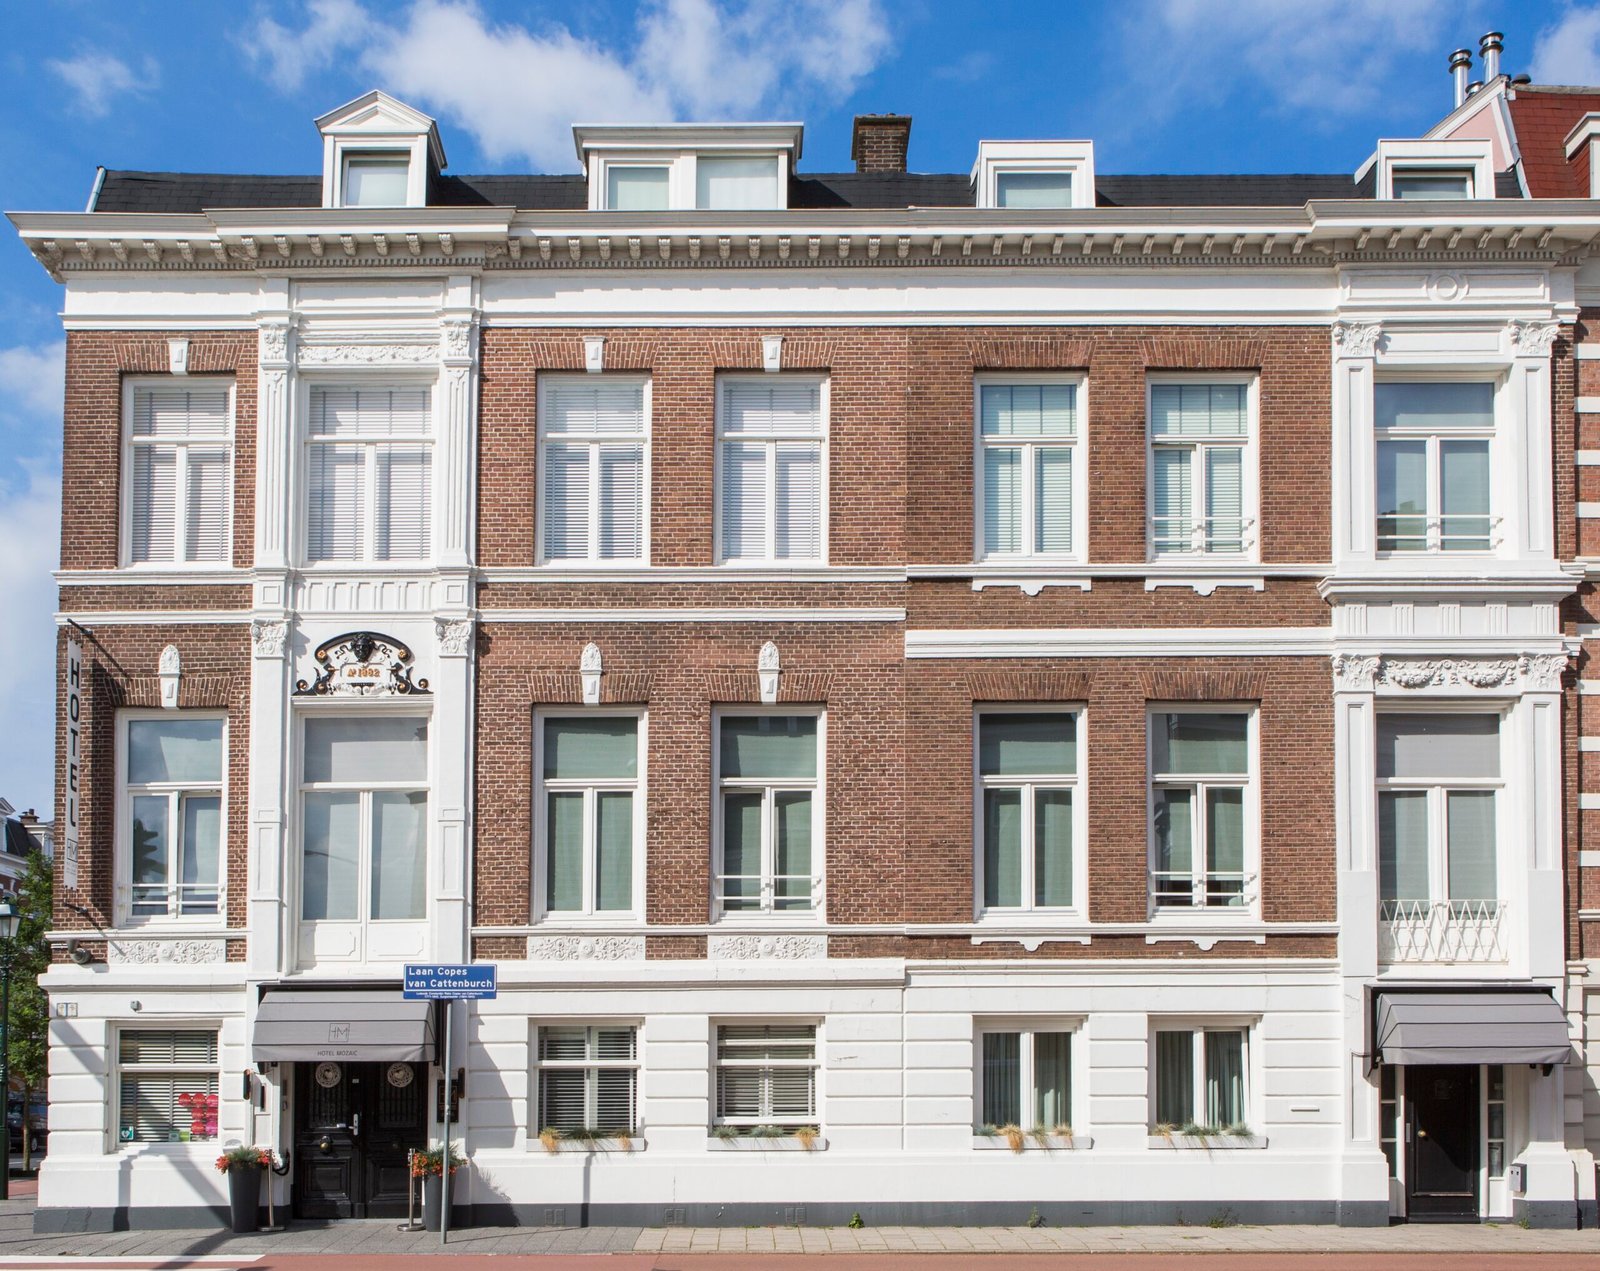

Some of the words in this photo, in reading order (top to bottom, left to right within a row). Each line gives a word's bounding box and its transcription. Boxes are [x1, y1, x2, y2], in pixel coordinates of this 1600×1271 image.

[70, 658, 80, 827] HOTEL
[408, 967, 434, 976] Laan
[437, 967, 468, 977] Copes
[408, 980, 426, 988] van
[430, 979, 493, 988] Cattenburch
